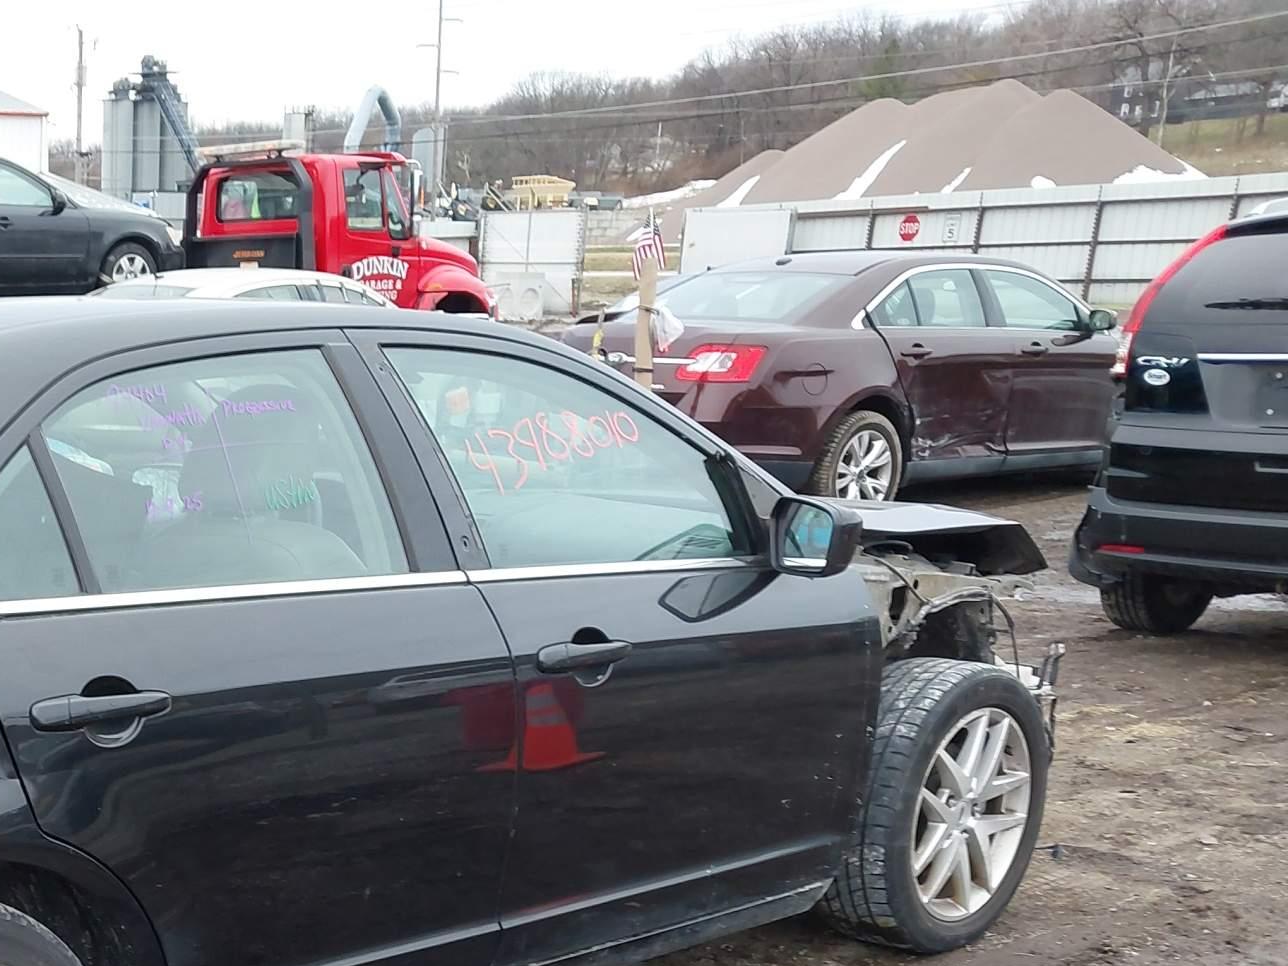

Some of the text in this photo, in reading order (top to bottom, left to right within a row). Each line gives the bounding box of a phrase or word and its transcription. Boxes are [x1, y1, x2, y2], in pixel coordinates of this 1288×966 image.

[900, 222, 920, 235] STOP
[947, 228, 955, 239] 5
[352, 256, 409, 280] DUNKIN
[395, 279, 402, 290] &
[464, 410, 639, 496] 43988010
